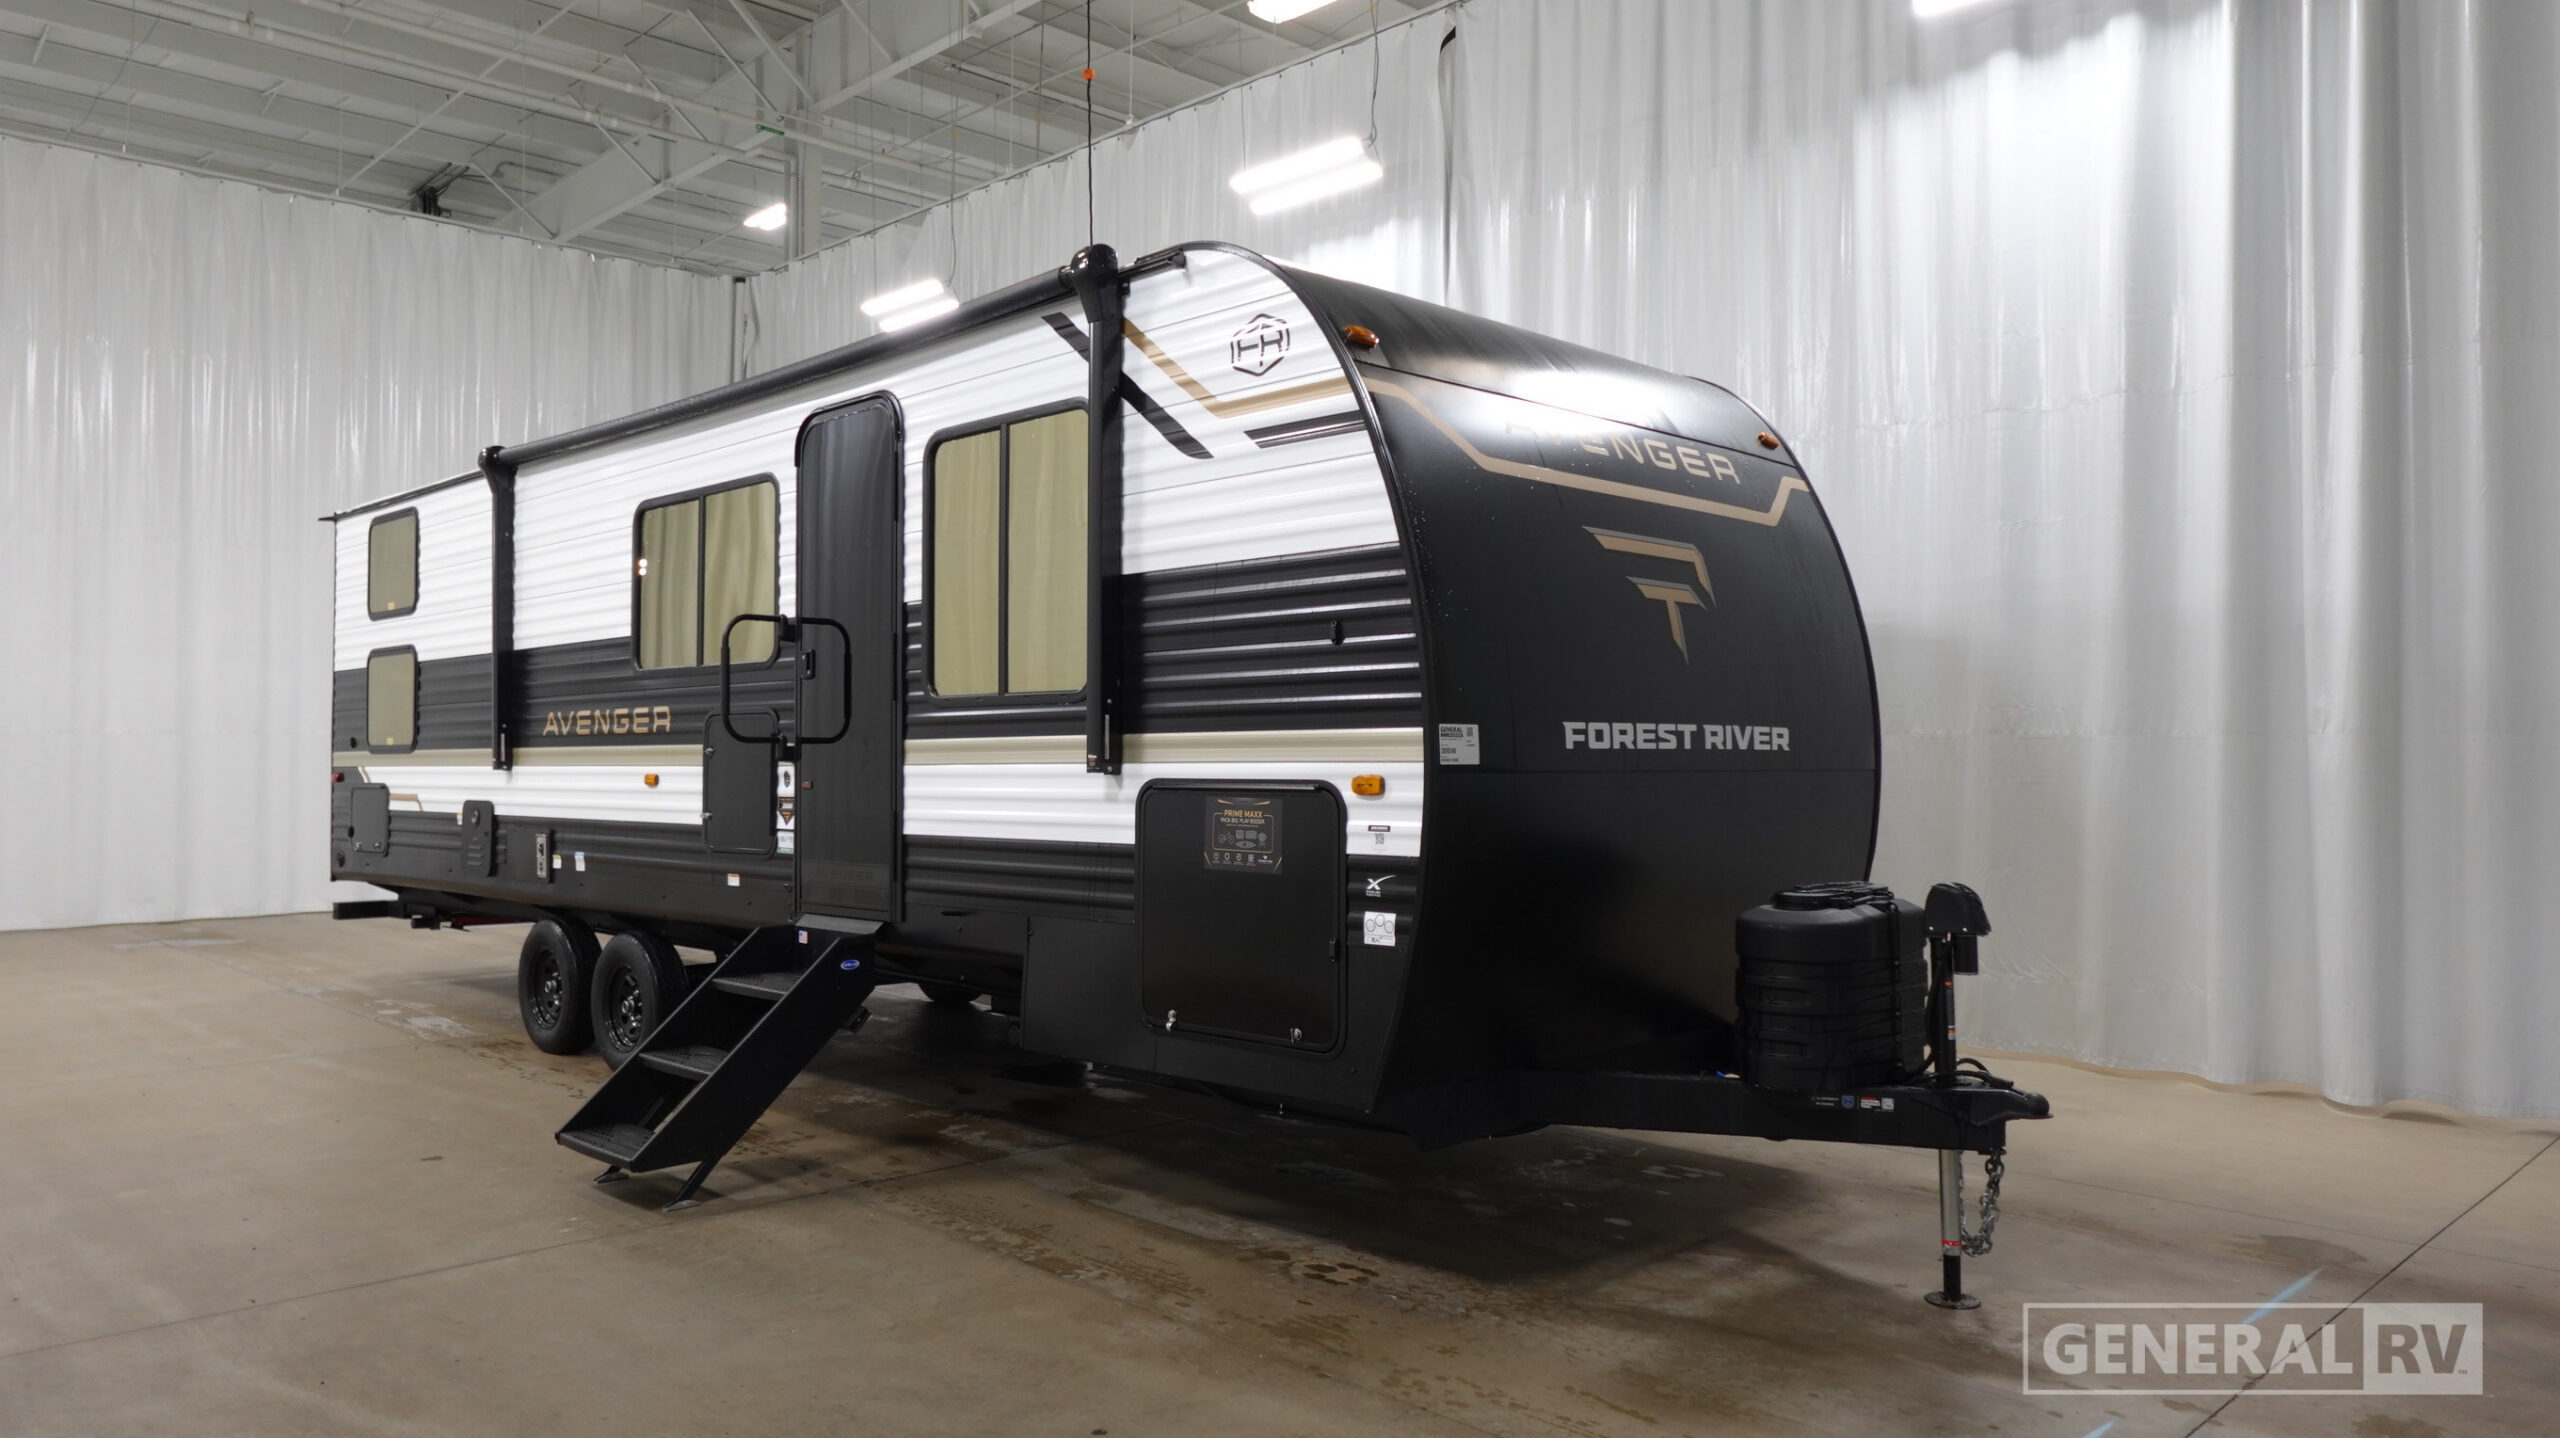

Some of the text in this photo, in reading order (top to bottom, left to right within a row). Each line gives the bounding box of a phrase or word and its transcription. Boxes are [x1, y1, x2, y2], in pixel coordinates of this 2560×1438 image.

[1505, 422, 1741, 485] ENGER
[542, 705, 671, 737] AVENGER
[1562, 721, 1791, 751] FOREST RIVER
[1224, 809, 1263, 819] PRIME MAXX
